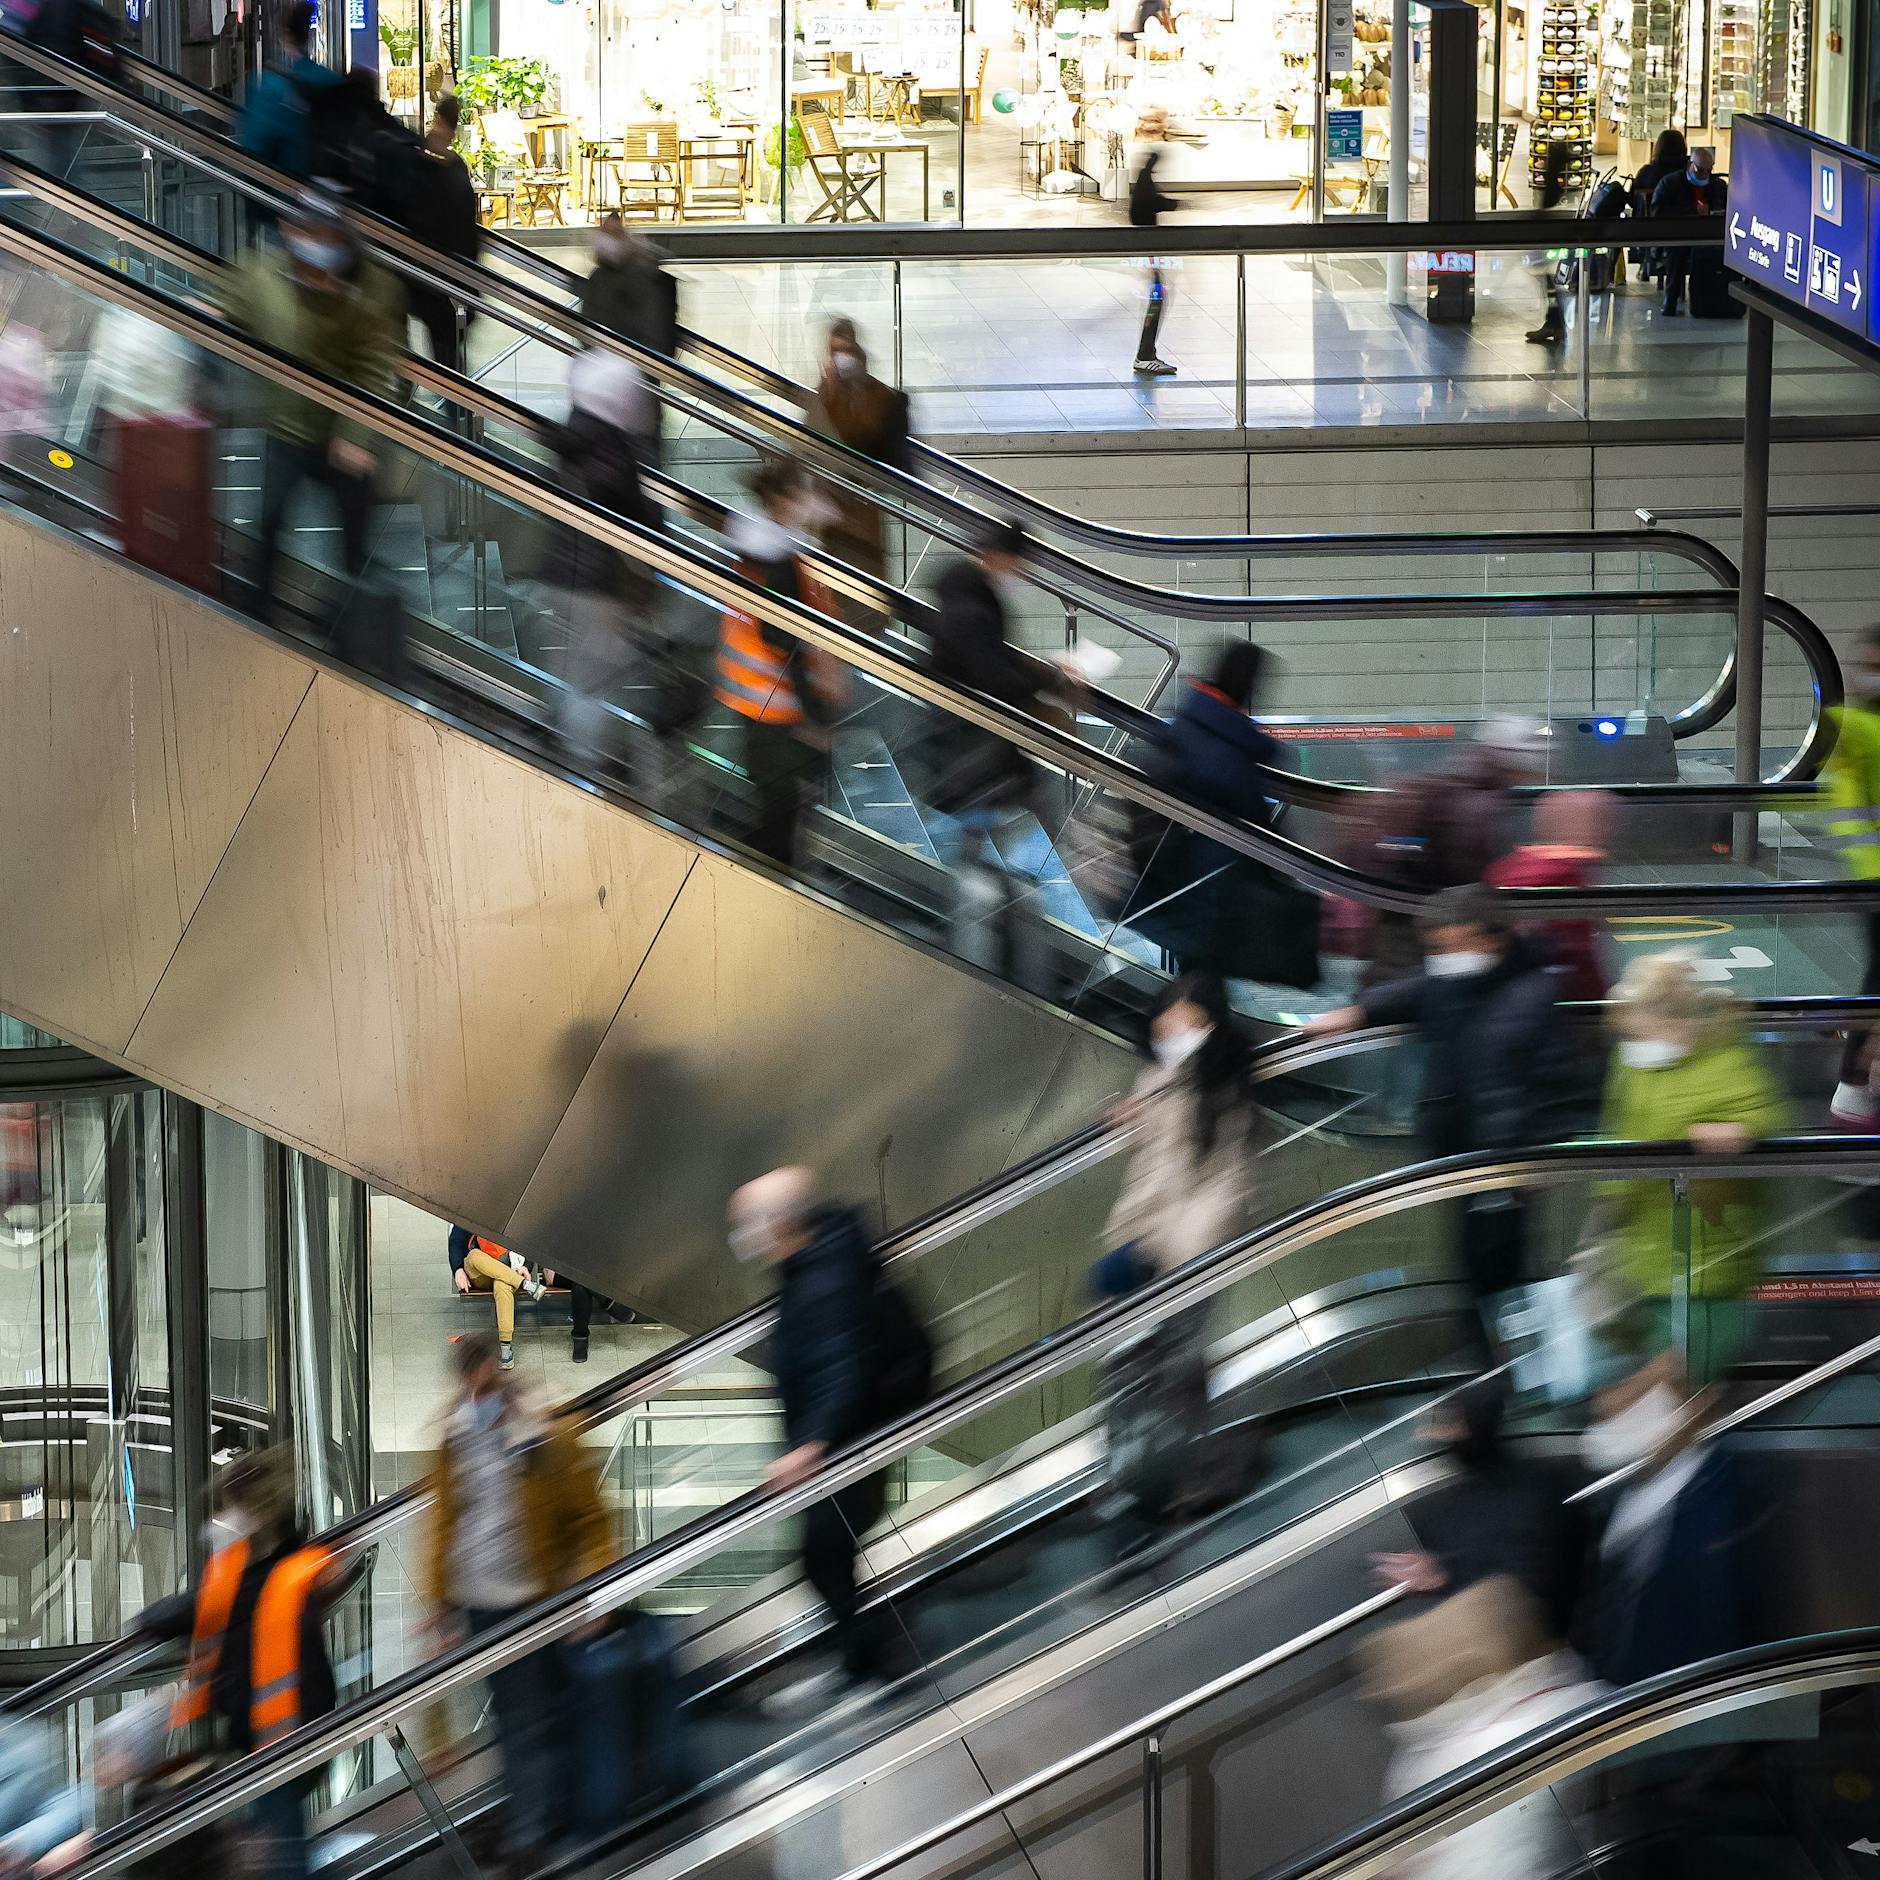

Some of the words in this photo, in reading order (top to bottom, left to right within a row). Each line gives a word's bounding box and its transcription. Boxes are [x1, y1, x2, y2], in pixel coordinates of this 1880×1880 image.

[1822, 169, 1834, 211] U
[1750, 215, 1780, 253] Ausgang
[1757, 1291, 1806, 1299] passengers
[1808, 1289, 1826, 1297] and
[1828, 1289, 1850, 1297] keep
[1811, 1281, 1854, 1289] Abstand
